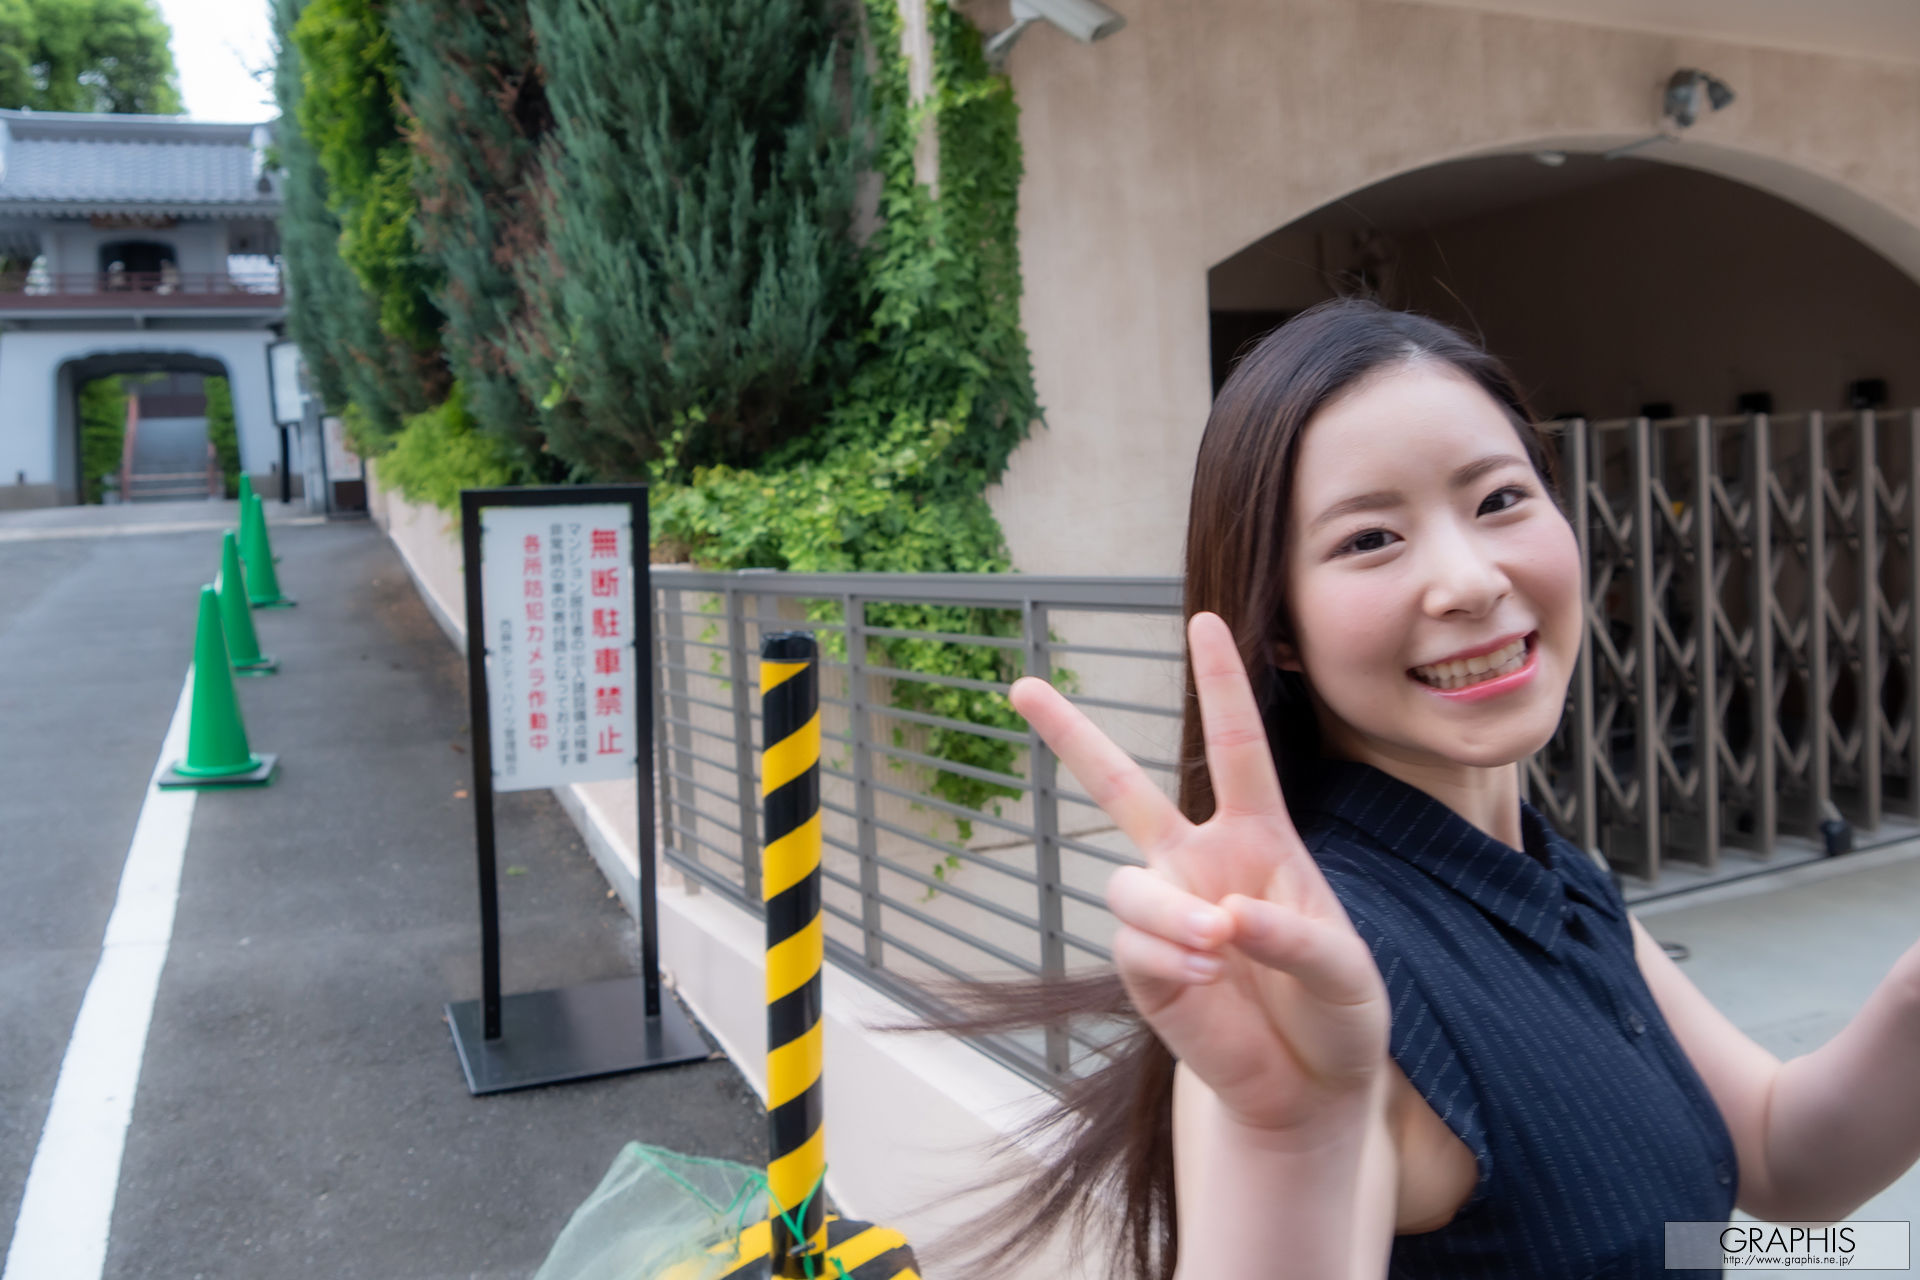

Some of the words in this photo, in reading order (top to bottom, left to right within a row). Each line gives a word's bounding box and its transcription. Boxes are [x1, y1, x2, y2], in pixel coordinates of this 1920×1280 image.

[523, 534, 549, 751] 各所防犯カメラ作動中
[590, 529, 624, 755] 無断駐車禁止
